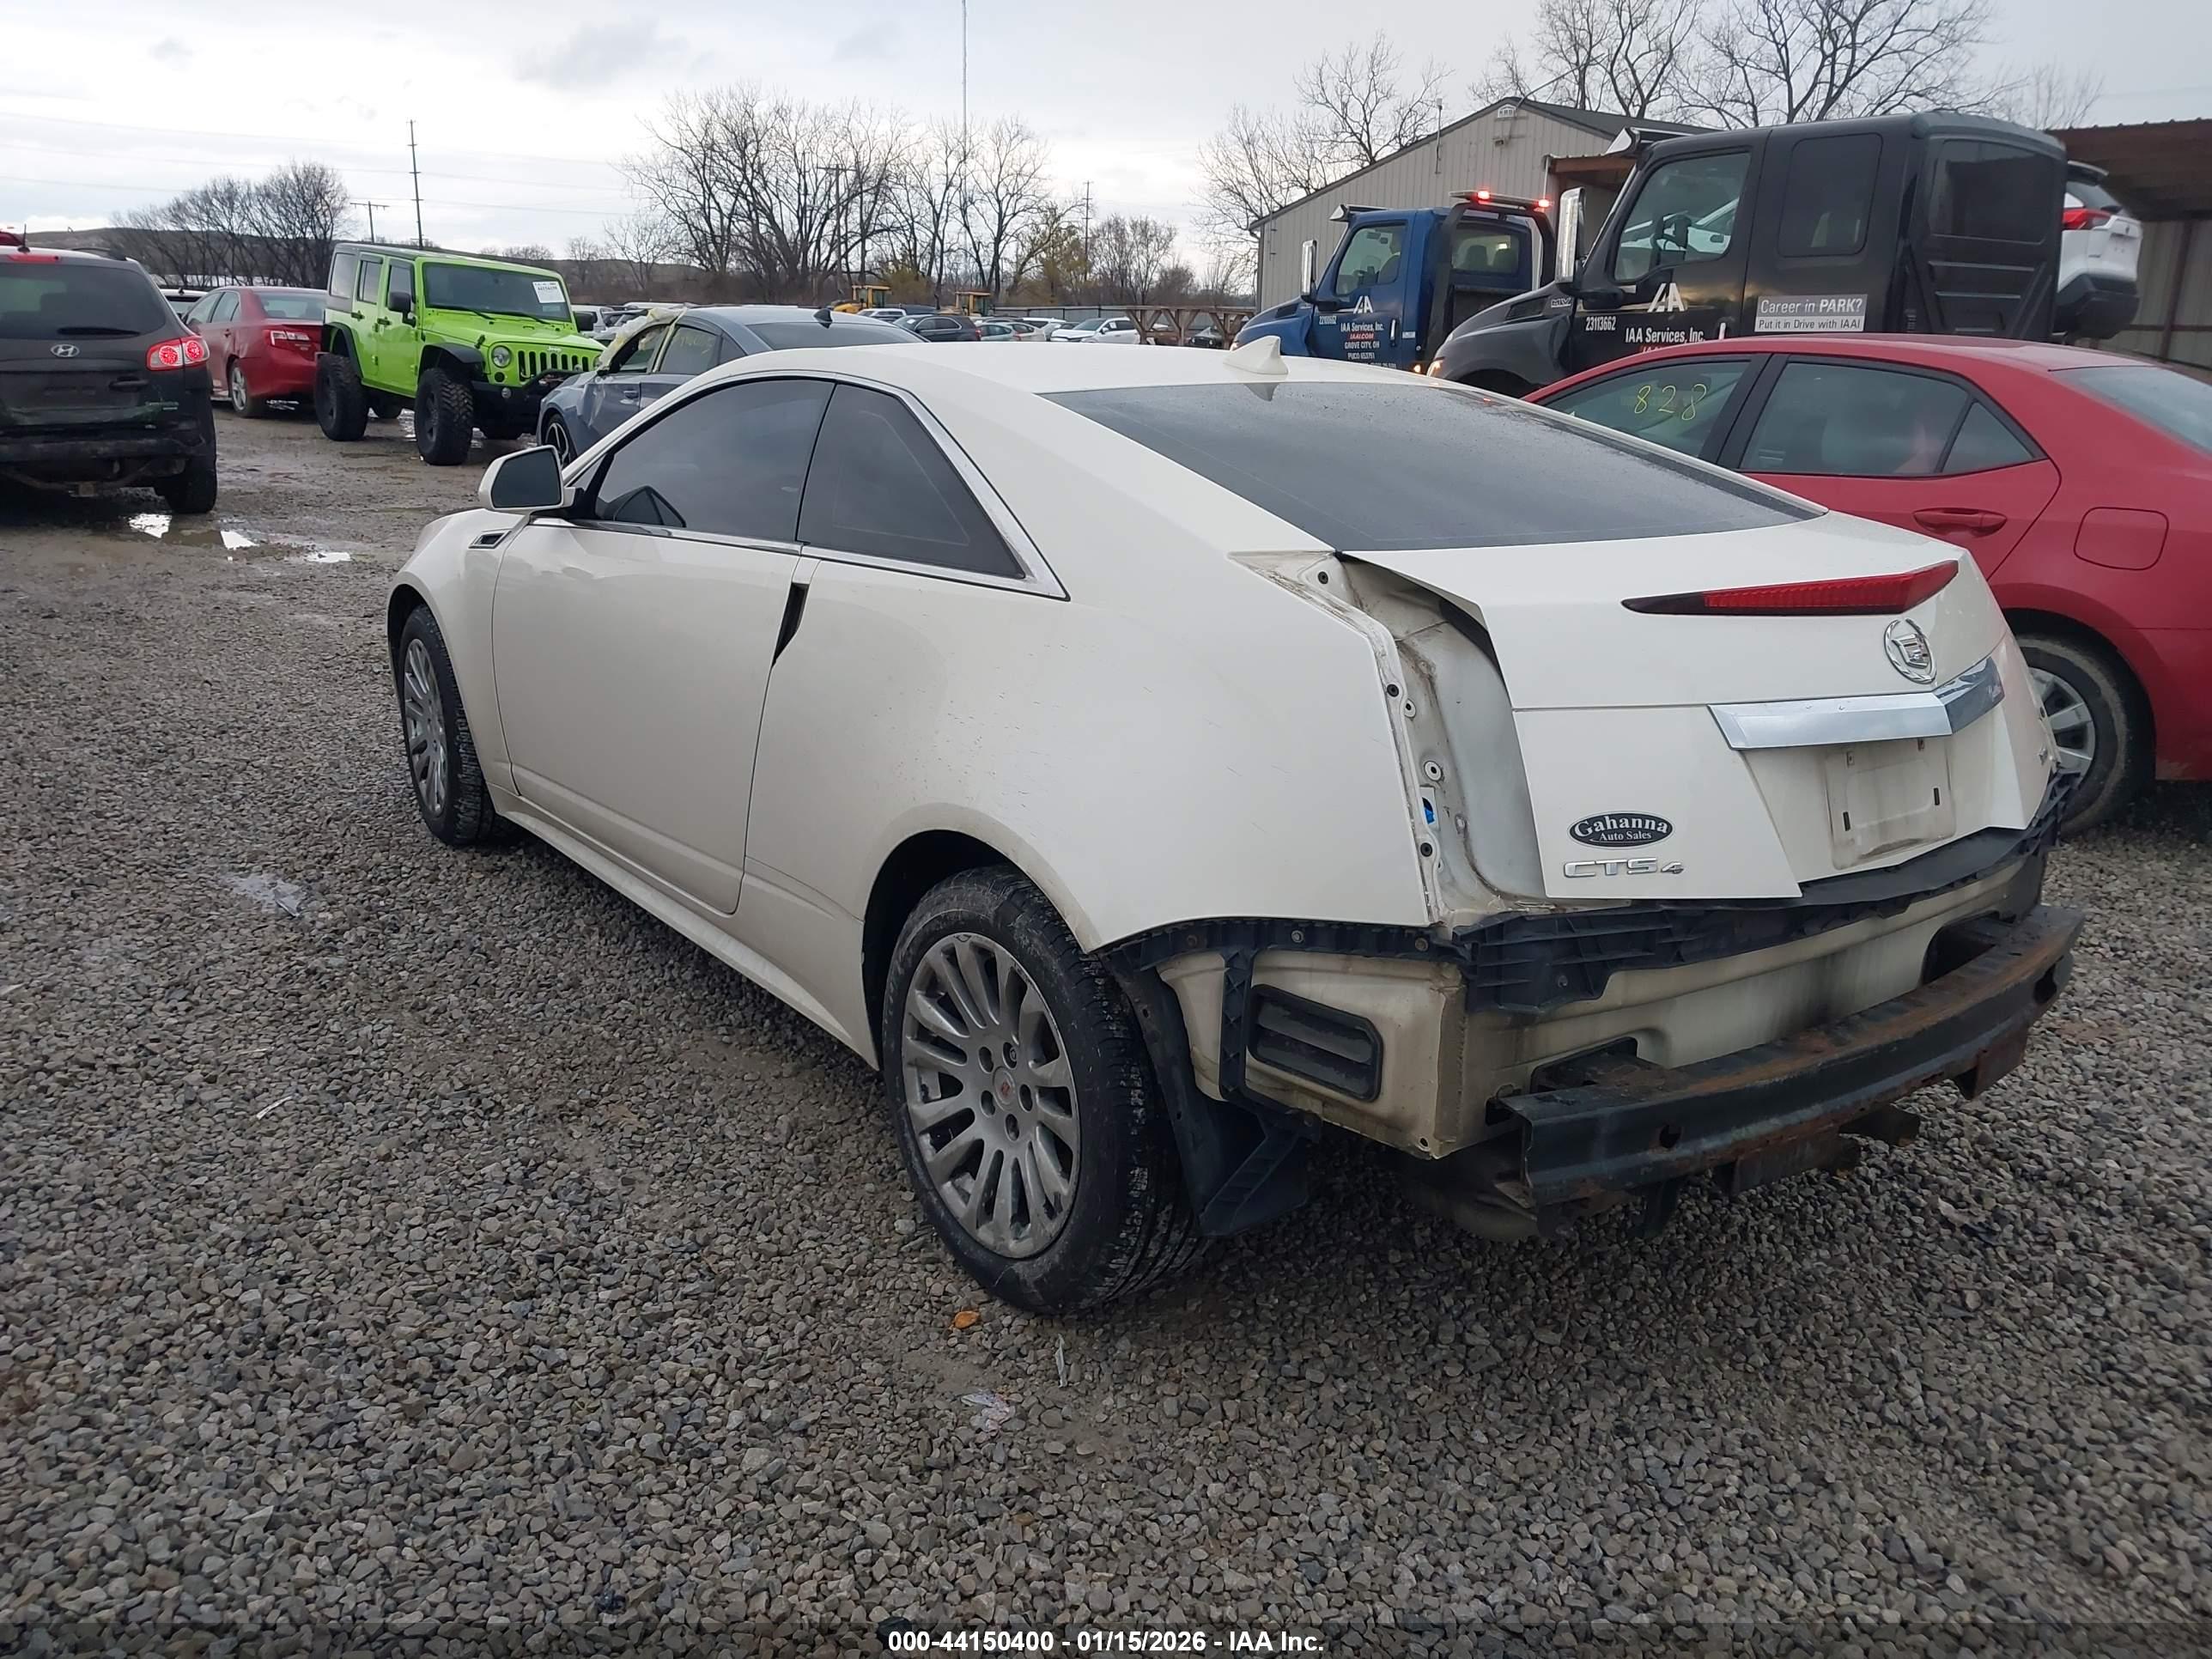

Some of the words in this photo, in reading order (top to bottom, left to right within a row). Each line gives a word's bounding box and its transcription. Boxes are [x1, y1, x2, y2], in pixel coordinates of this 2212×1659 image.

[1760, 299, 1802, 313] Career
[1805, 299, 1815, 313] in
[1820, 298, 1863, 313] PARK?
[1340, 322, 1352, 332] IAA
[1375, 321, 1384, 331] Inc.
[1585, 315, 1617, 331] 23113662
[1759, 319, 1773, 329] Put
[1775, 319, 1781, 329] it
[1784, 319, 1790, 329] in
[1794, 319, 1814, 329] Drive
[1818, 319, 1837, 329] with
[1840, 319, 1861, 329] IAAI
[1626, 327, 1643, 343] IAA
[1645, 327, 1688, 344] Services,
[1689, 326, 1706, 343] Inc.
[1634, 383, 1707, 421] 828
[1574, 815, 1668, 837] Gahanna
[1600, 832, 1624, 842] Auto
[1626, 830, 1652, 841] Sales
